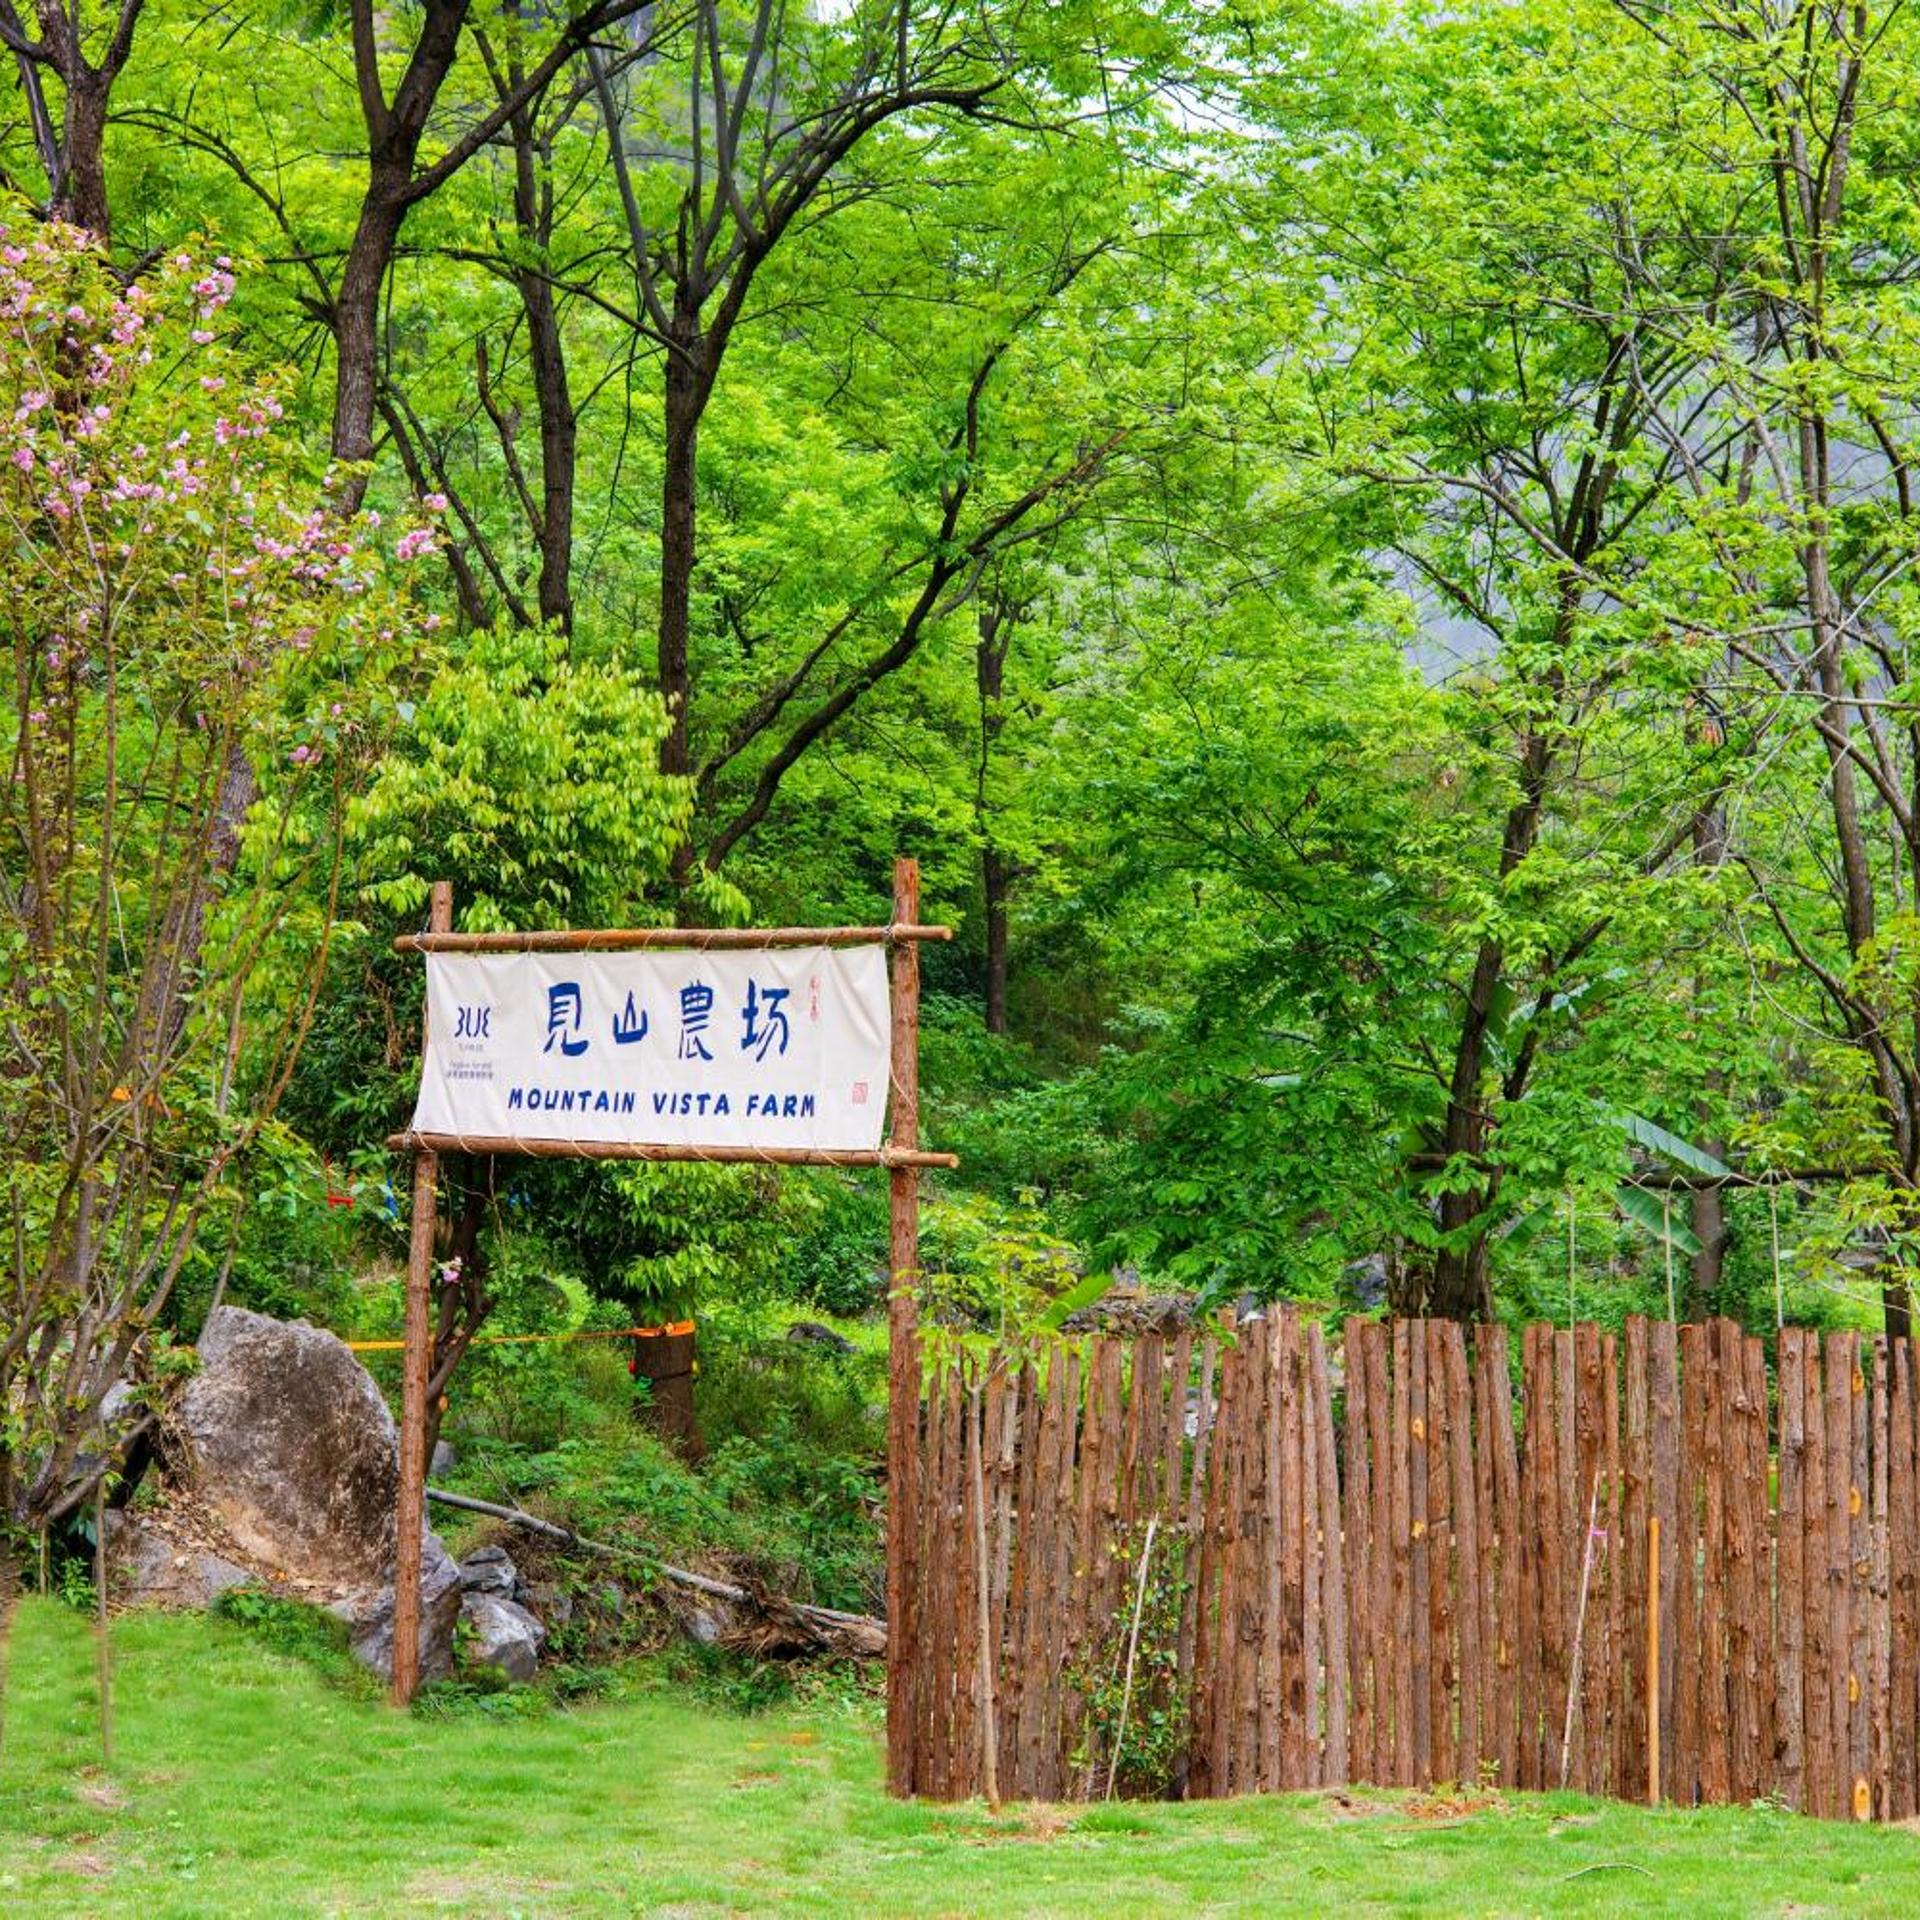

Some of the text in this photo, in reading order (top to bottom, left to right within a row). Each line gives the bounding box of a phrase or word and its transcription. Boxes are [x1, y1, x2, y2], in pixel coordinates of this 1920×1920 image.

[508, 1088, 815, 1118] MOUNTAIN VISTA FARM
